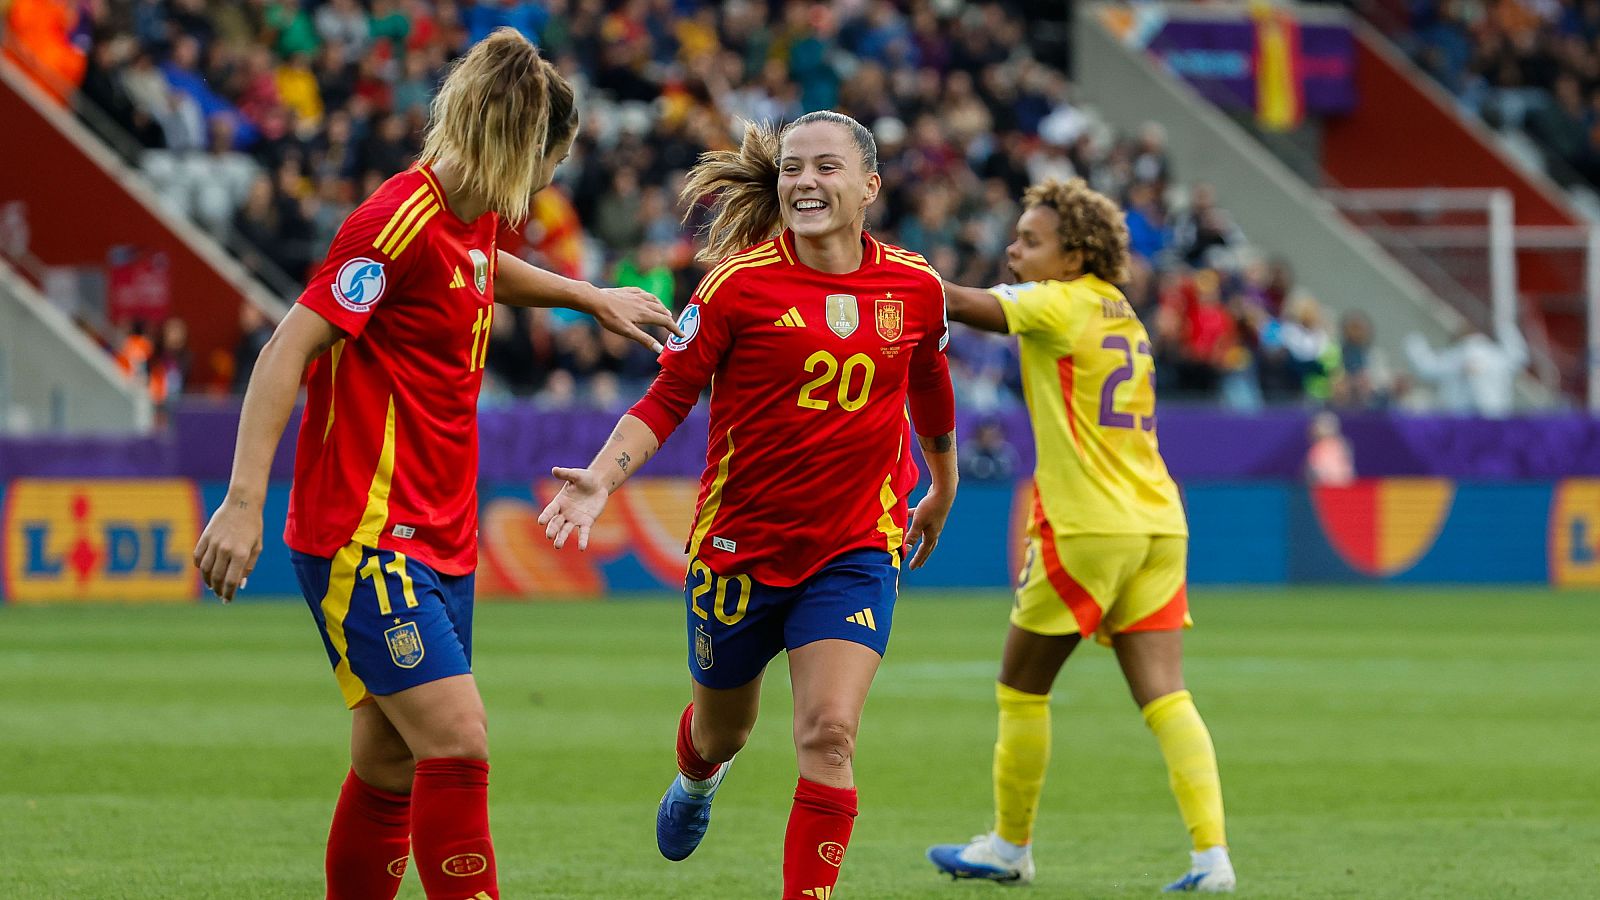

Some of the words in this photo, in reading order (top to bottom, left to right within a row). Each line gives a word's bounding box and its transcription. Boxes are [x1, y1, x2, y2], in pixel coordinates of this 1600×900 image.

[470, 305, 493, 372] 11
[797, 350, 876, 412] 20
[359, 551, 419, 616] 11
[690, 559, 752, 626] 20
